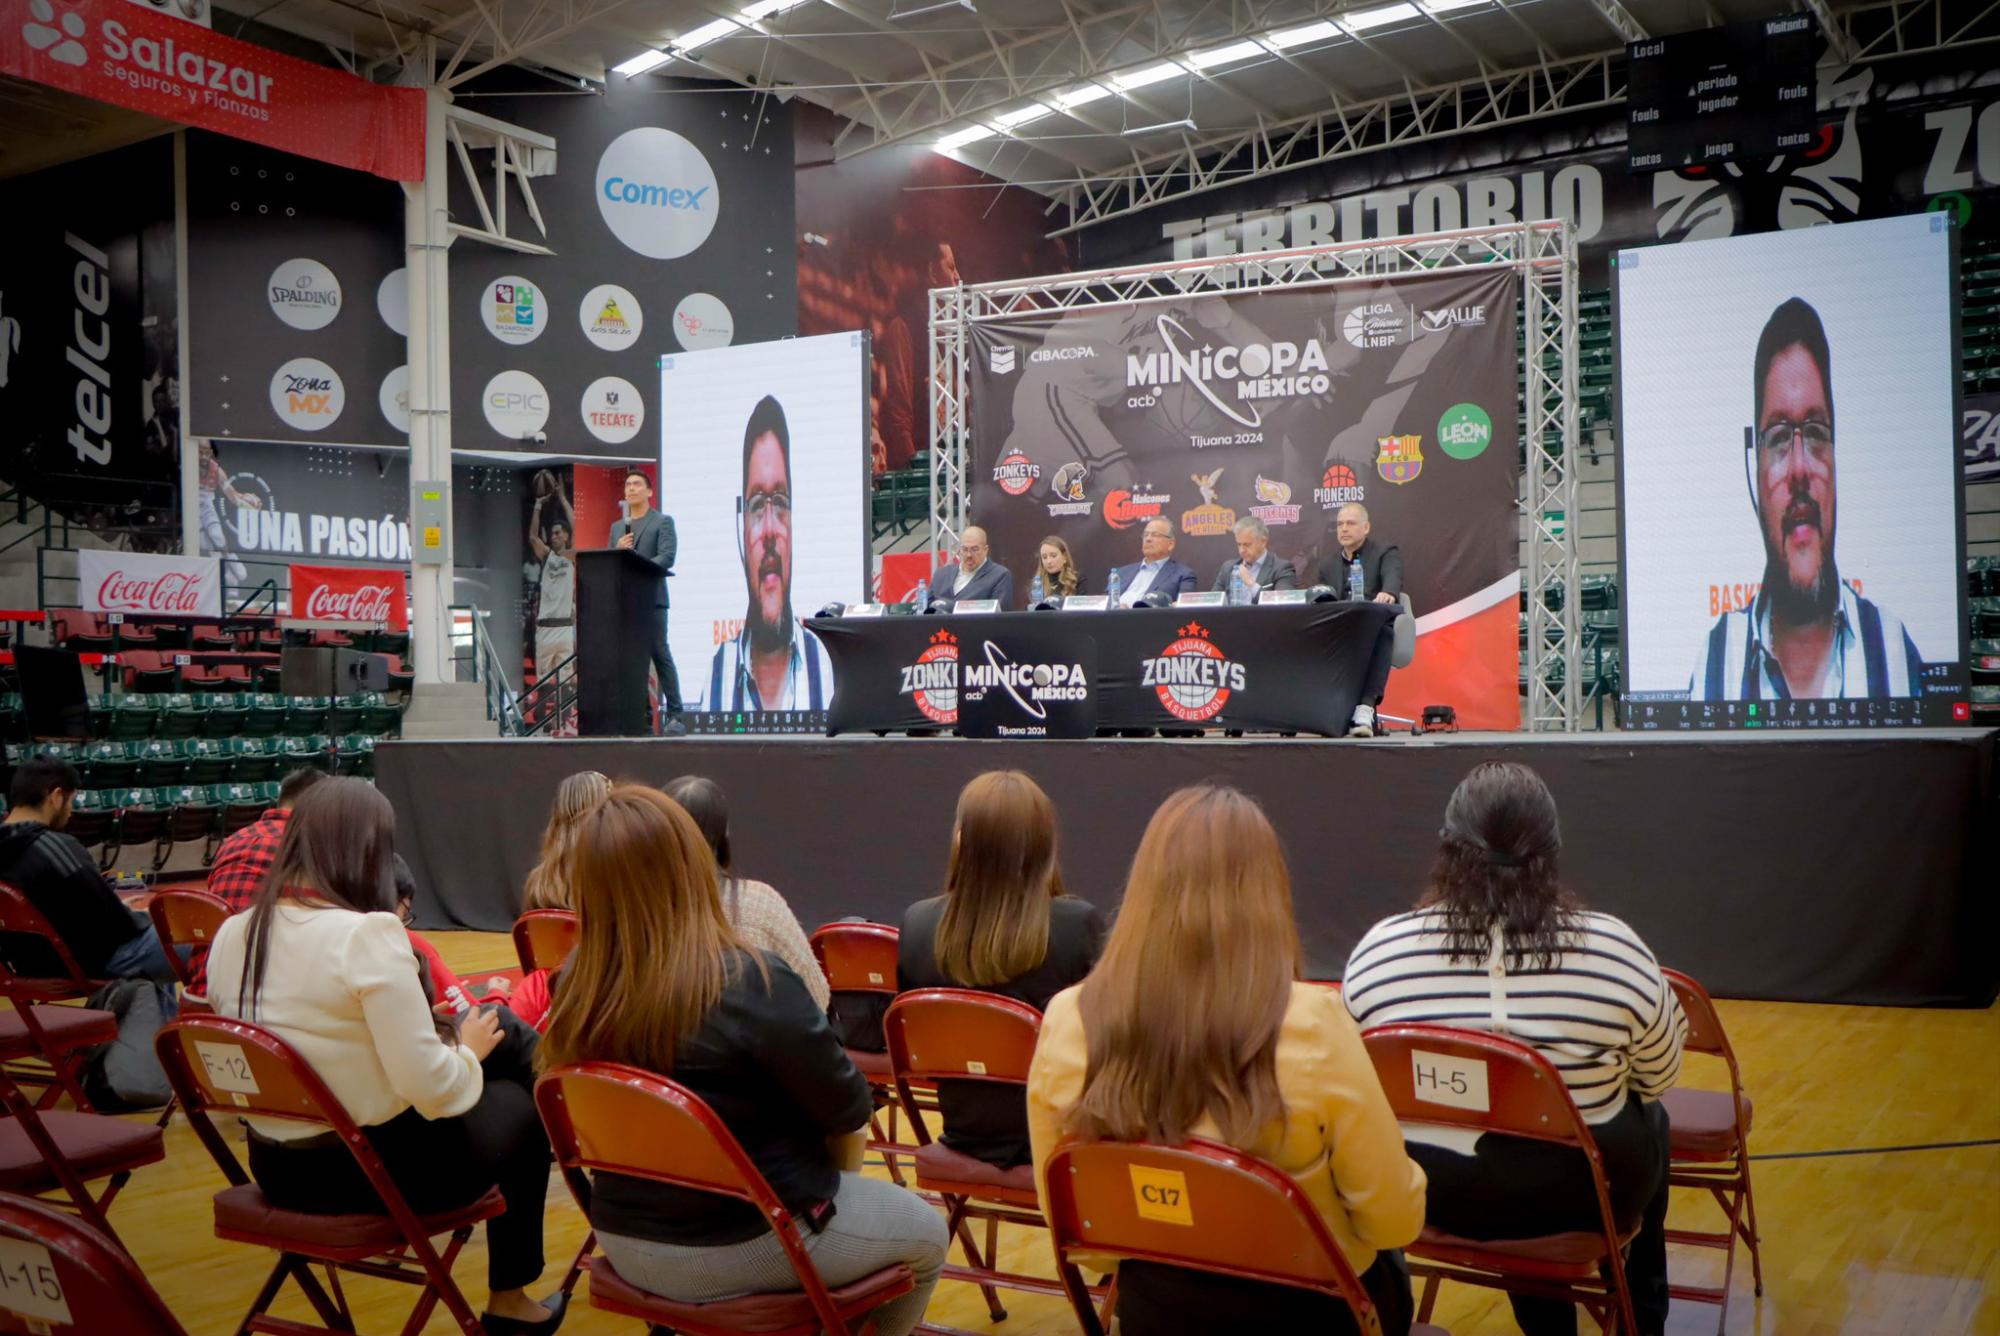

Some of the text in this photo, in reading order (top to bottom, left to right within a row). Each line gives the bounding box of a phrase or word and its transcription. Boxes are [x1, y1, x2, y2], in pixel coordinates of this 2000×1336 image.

[1766, 18, 1808, 35] Visitante
[1633, 41, 1665, 59] Local
[101, 19, 275, 104] Salazar
[103, 60, 270, 122] Seguros y Fianzas
[1697, 74, 1738, 92] periodo
[1778, 85, 1808, 101] fouls
[1697, 95, 1739, 114] jugador
[1632, 107, 1660, 123] fouls
[1777, 132, 1810, 147] tantos
[1631, 153, 1662, 167] tantos
[1703, 142, 1734, 159] juego
[603, 176, 709, 211] Comex
[1162, 164, 1604, 289] TERRITORIO
[271, 286, 338, 306] SPALDING
[1363, 304, 1393, 316] LIGA
[1422, 306, 1486, 327] VALUE
[65, 230, 112, 465] telcel
[1364, 336, 1396, 348] LNBP
[1030, 346, 1095, 362] CIBACOPA
[282, 374, 331, 394] Zona
[1237, 374, 1330, 400] MÉXICO
[490, 392, 543, 411] EPIC
[1127, 394, 1156, 408] acb
[590, 412, 636, 427] TECATE
[1190, 433, 1264, 448] Tijuana 2024
[993, 464, 1040, 480] ZONKEYS
[1314, 486, 1364, 502] PIONEROS
[237, 507, 304, 552] UNA
[98, 570, 203, 611] Coca-Cola
[306, 584, 395, 620] Coca-Cola
[1172, 641, 1212, 655] TIJUANA
[900, 664, 958, 694] ZONK
[1142, 657, 1245, 691] ZONKEYS
[965, 692, 983, 700] acb
[1031, 686, 1088, 700] MÉXICO
[917, 697, 958, 722] BASQUET
[1161, 692, 1222, 720] BASQUETBOL
[997, 726, 1046, 736] Tijuana 2024
[201, 1052, 251, 1081] F-12
[1416, 1063, 1468, 1095] H-5
[1141, 1184, 1181, 1207] C17
